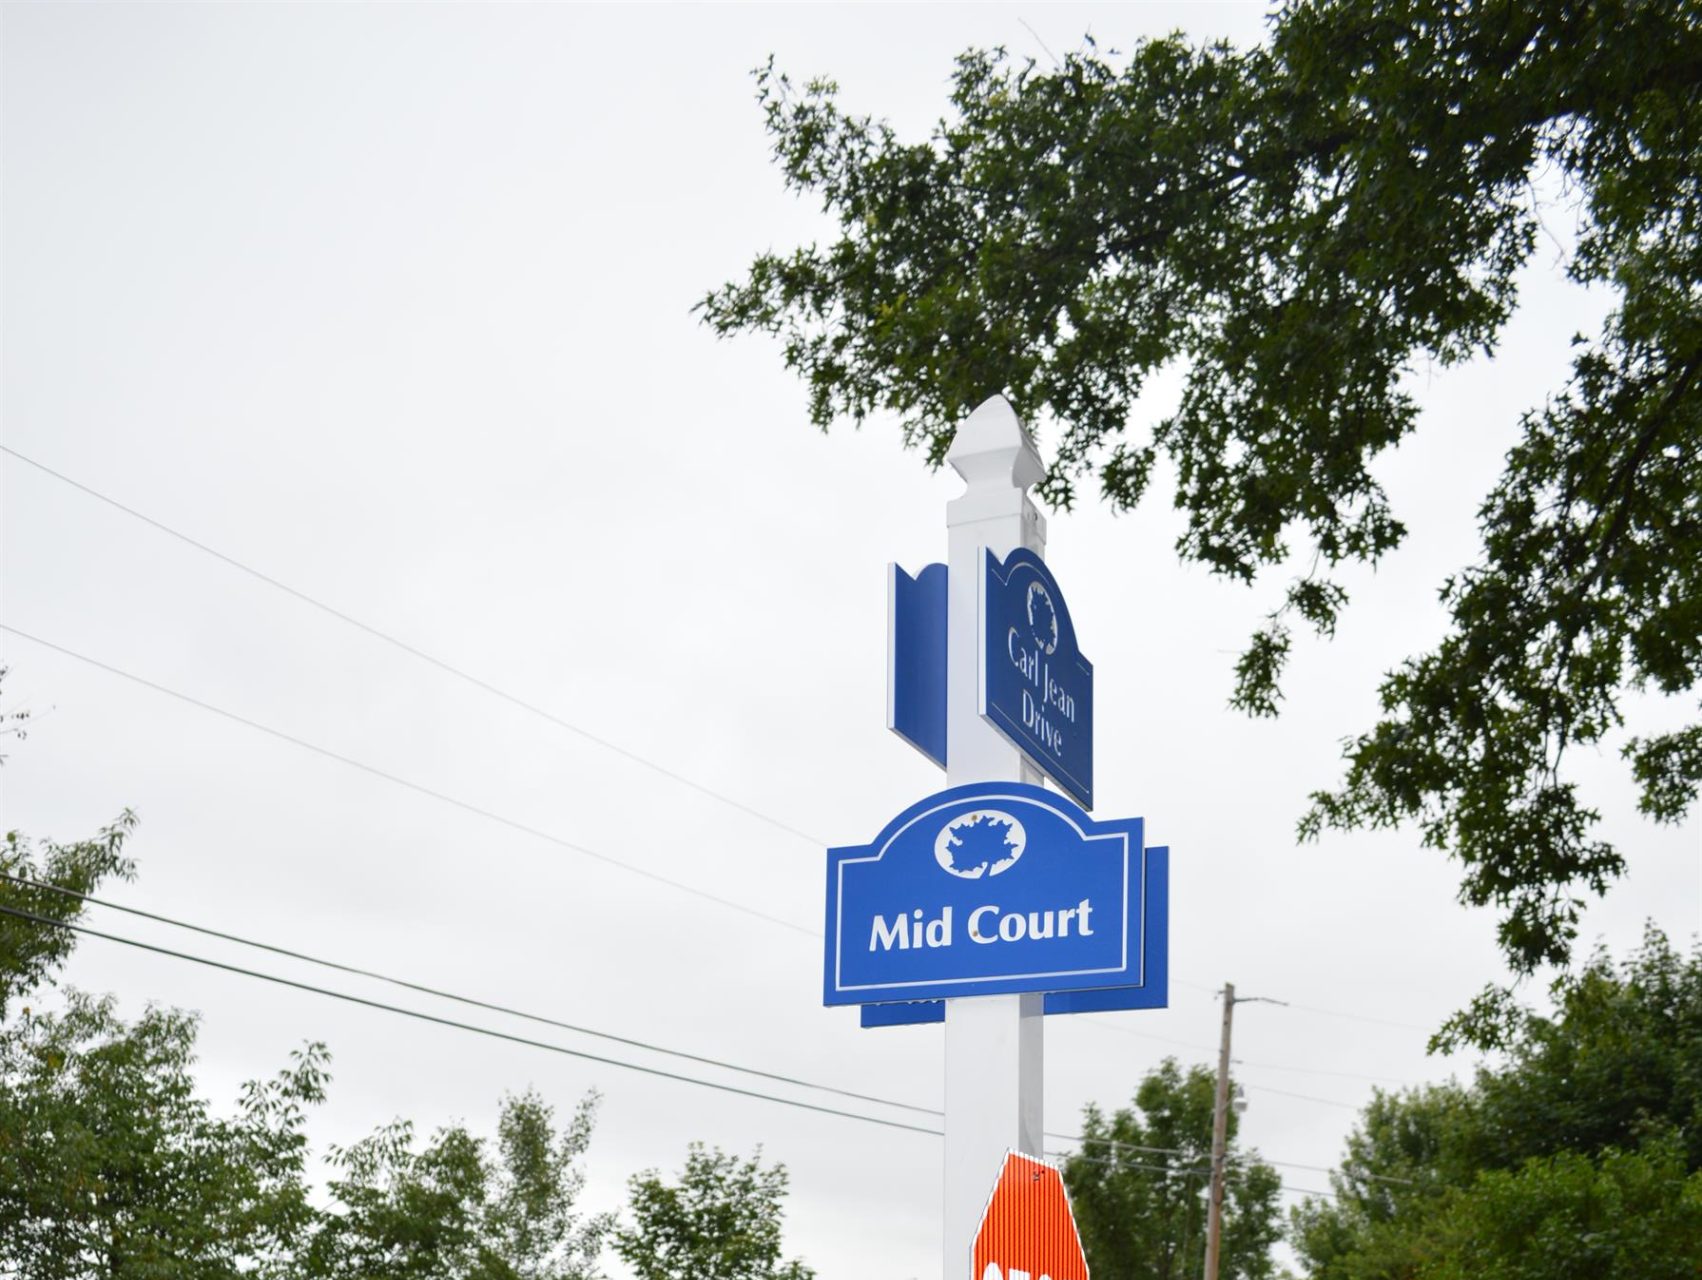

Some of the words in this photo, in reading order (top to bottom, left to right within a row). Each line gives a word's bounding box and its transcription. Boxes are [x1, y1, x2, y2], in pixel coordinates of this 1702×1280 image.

[1007, 626, 1040, 687] Carl
[1042, 662, 1076, 722] Jean
[1022, 689, 1063, 757] Drive
[869, 906, 953, 953] Mid
[967, 898, 1094, 944] Court
